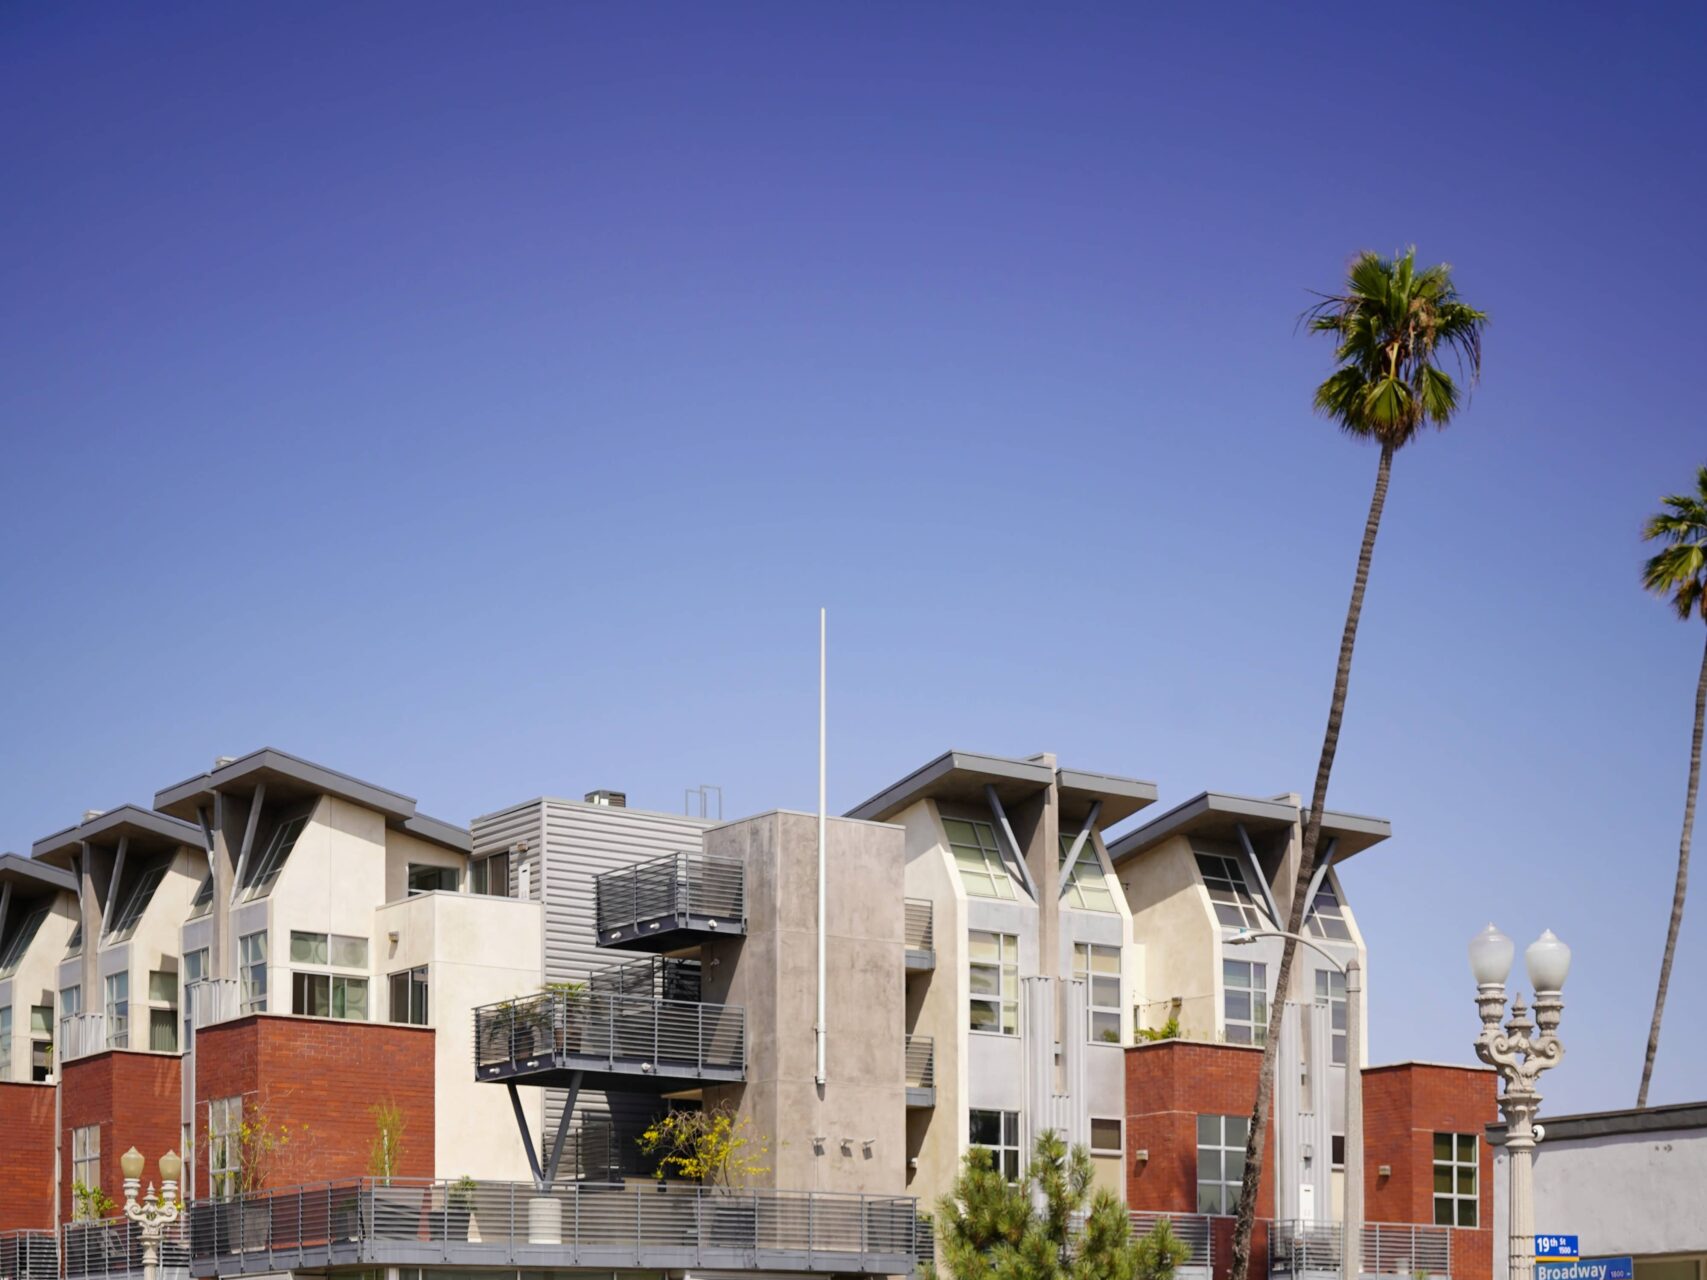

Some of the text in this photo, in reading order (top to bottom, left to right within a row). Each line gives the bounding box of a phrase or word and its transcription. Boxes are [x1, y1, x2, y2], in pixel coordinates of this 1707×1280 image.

[1537, 1237, 1566, 1252] 19th St
[1538, 1262, 1607, 1280] Broadway
